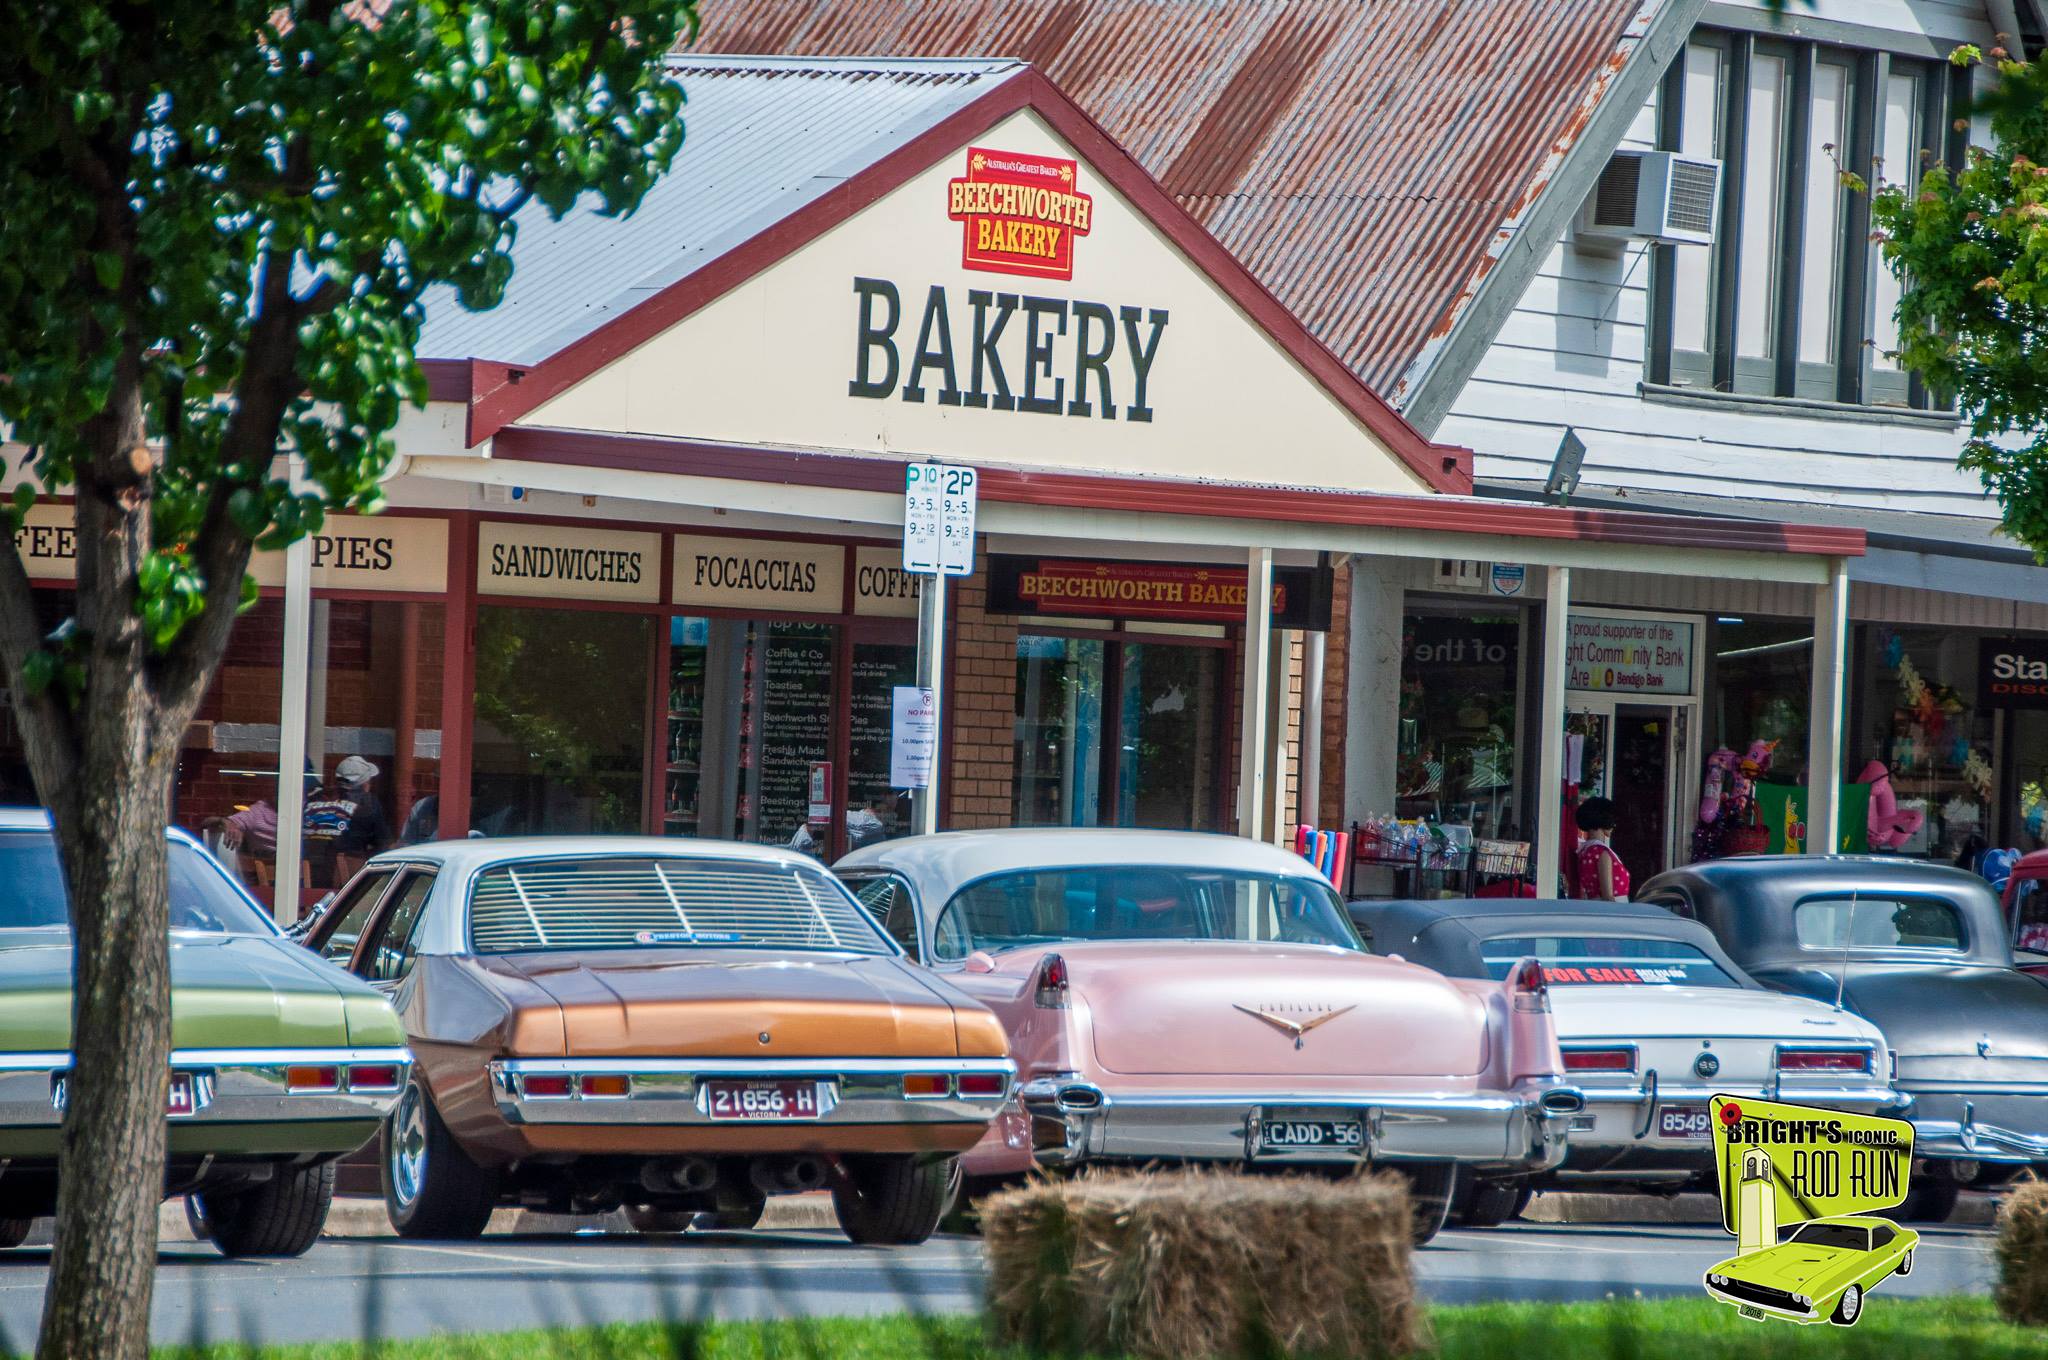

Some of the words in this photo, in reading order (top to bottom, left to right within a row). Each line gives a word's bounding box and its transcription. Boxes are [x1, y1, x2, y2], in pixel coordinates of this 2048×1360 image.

[950, 182, 1091, 231] BEECHWORTH
[977, 219, 1061, 259] BAKERY
[848, 276, 1169, 423] BAKERY
[946, 470, 973, 496] 2P
[311, 535, 393, 571] PIES
[491, 543, 641, 584] SANDWICHES
[694, 554, 817, 593] FOCACCIAS
[1021, 575, 1183, 603] BEECHWORTH
[1188, 583, 1283, 607] BAKEY
[1573, 622, 1601, 639] proud
[1602, 624, 1646, 640] supporter
[1648, 624, 1658, 640] of
[1659, 626, 1673, 641] the
[1656, 646, 1684, 667] Bank
[1570, 666, 1590, 687] Are
[1617, 671, 1645, 688] Bendigo
[1647, 673, 1664, 687] Bank
[1542, 968, 1588, 982] FOR
[1585, 968, 1643, 982] SALE
